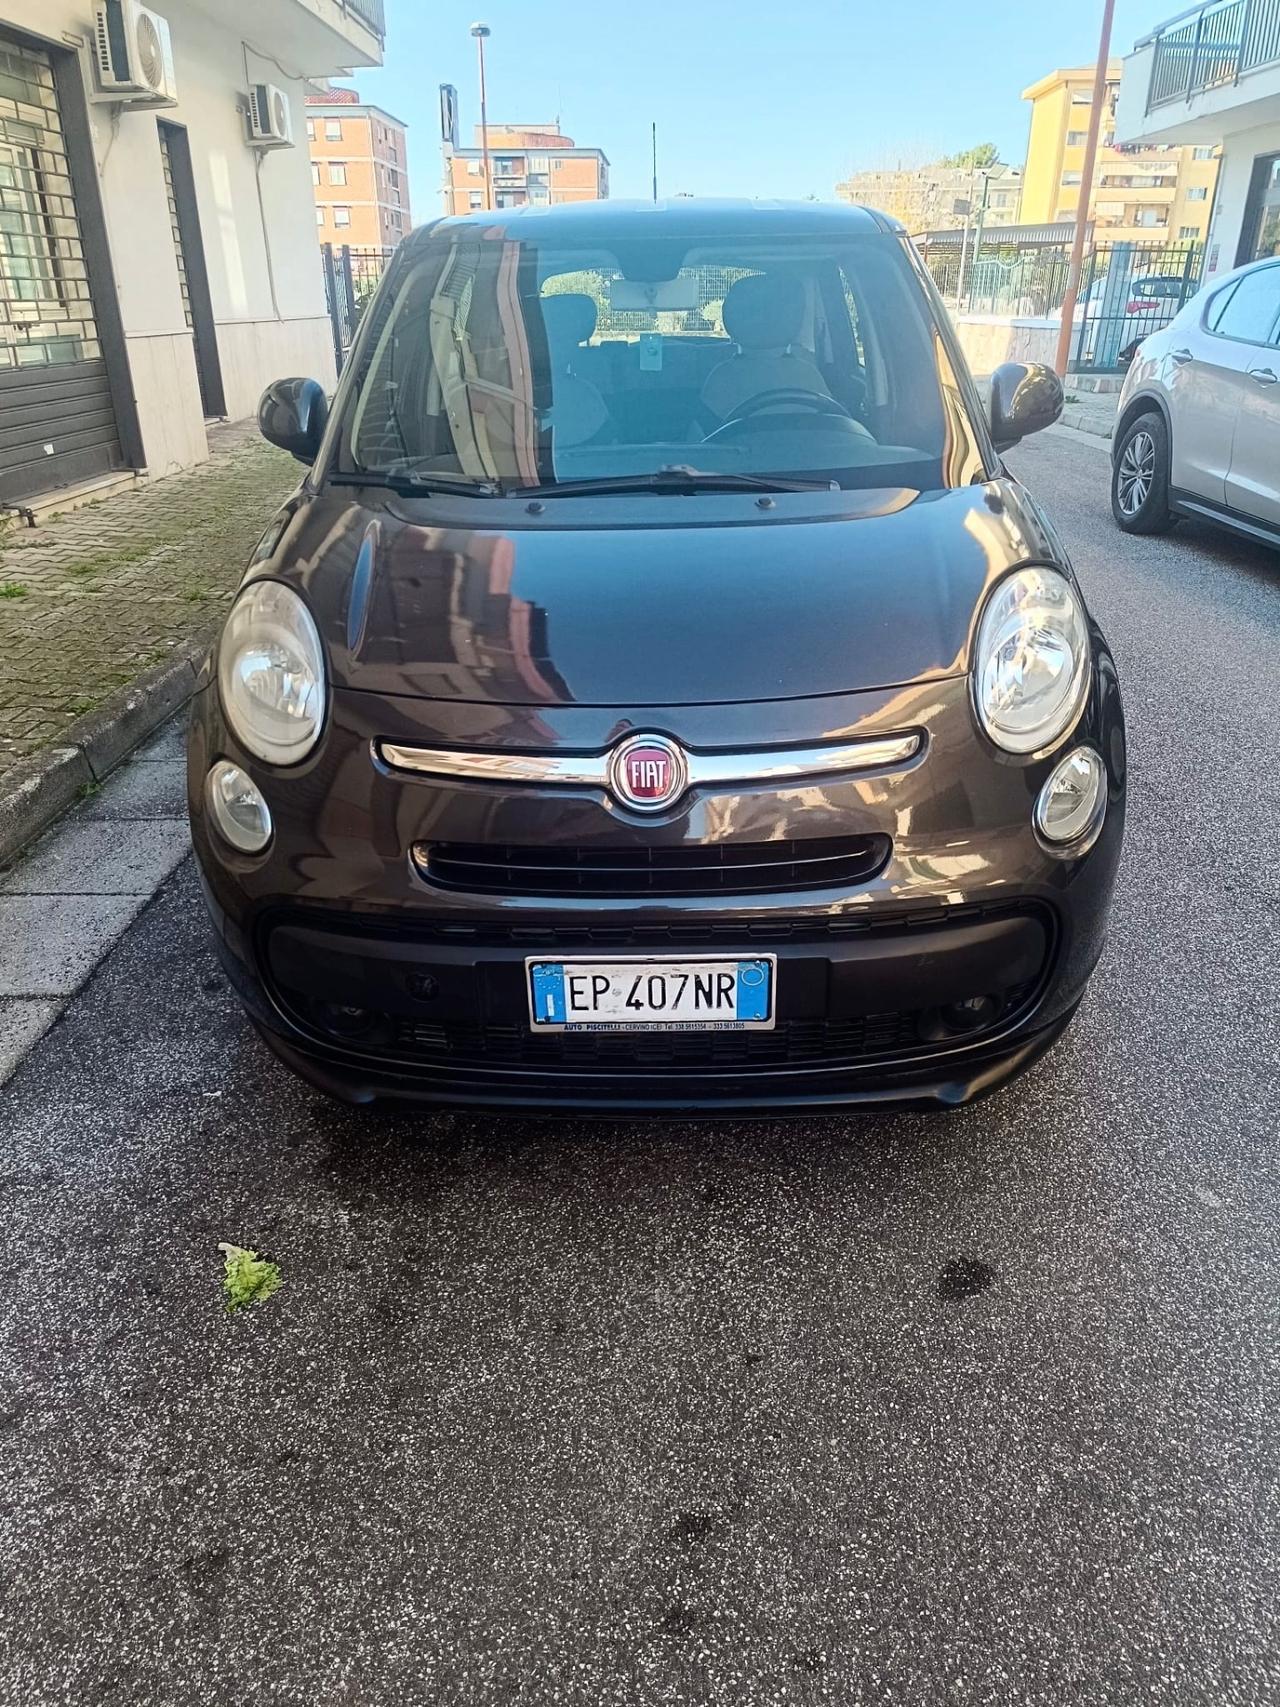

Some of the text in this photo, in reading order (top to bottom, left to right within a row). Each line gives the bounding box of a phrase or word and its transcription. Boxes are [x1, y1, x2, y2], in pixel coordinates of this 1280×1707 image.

[631, 760, 666, 788] FIAT
[569, 973, 735, 1011] EP 407NR
[625, 1023, 649, 1031] CERVINO
